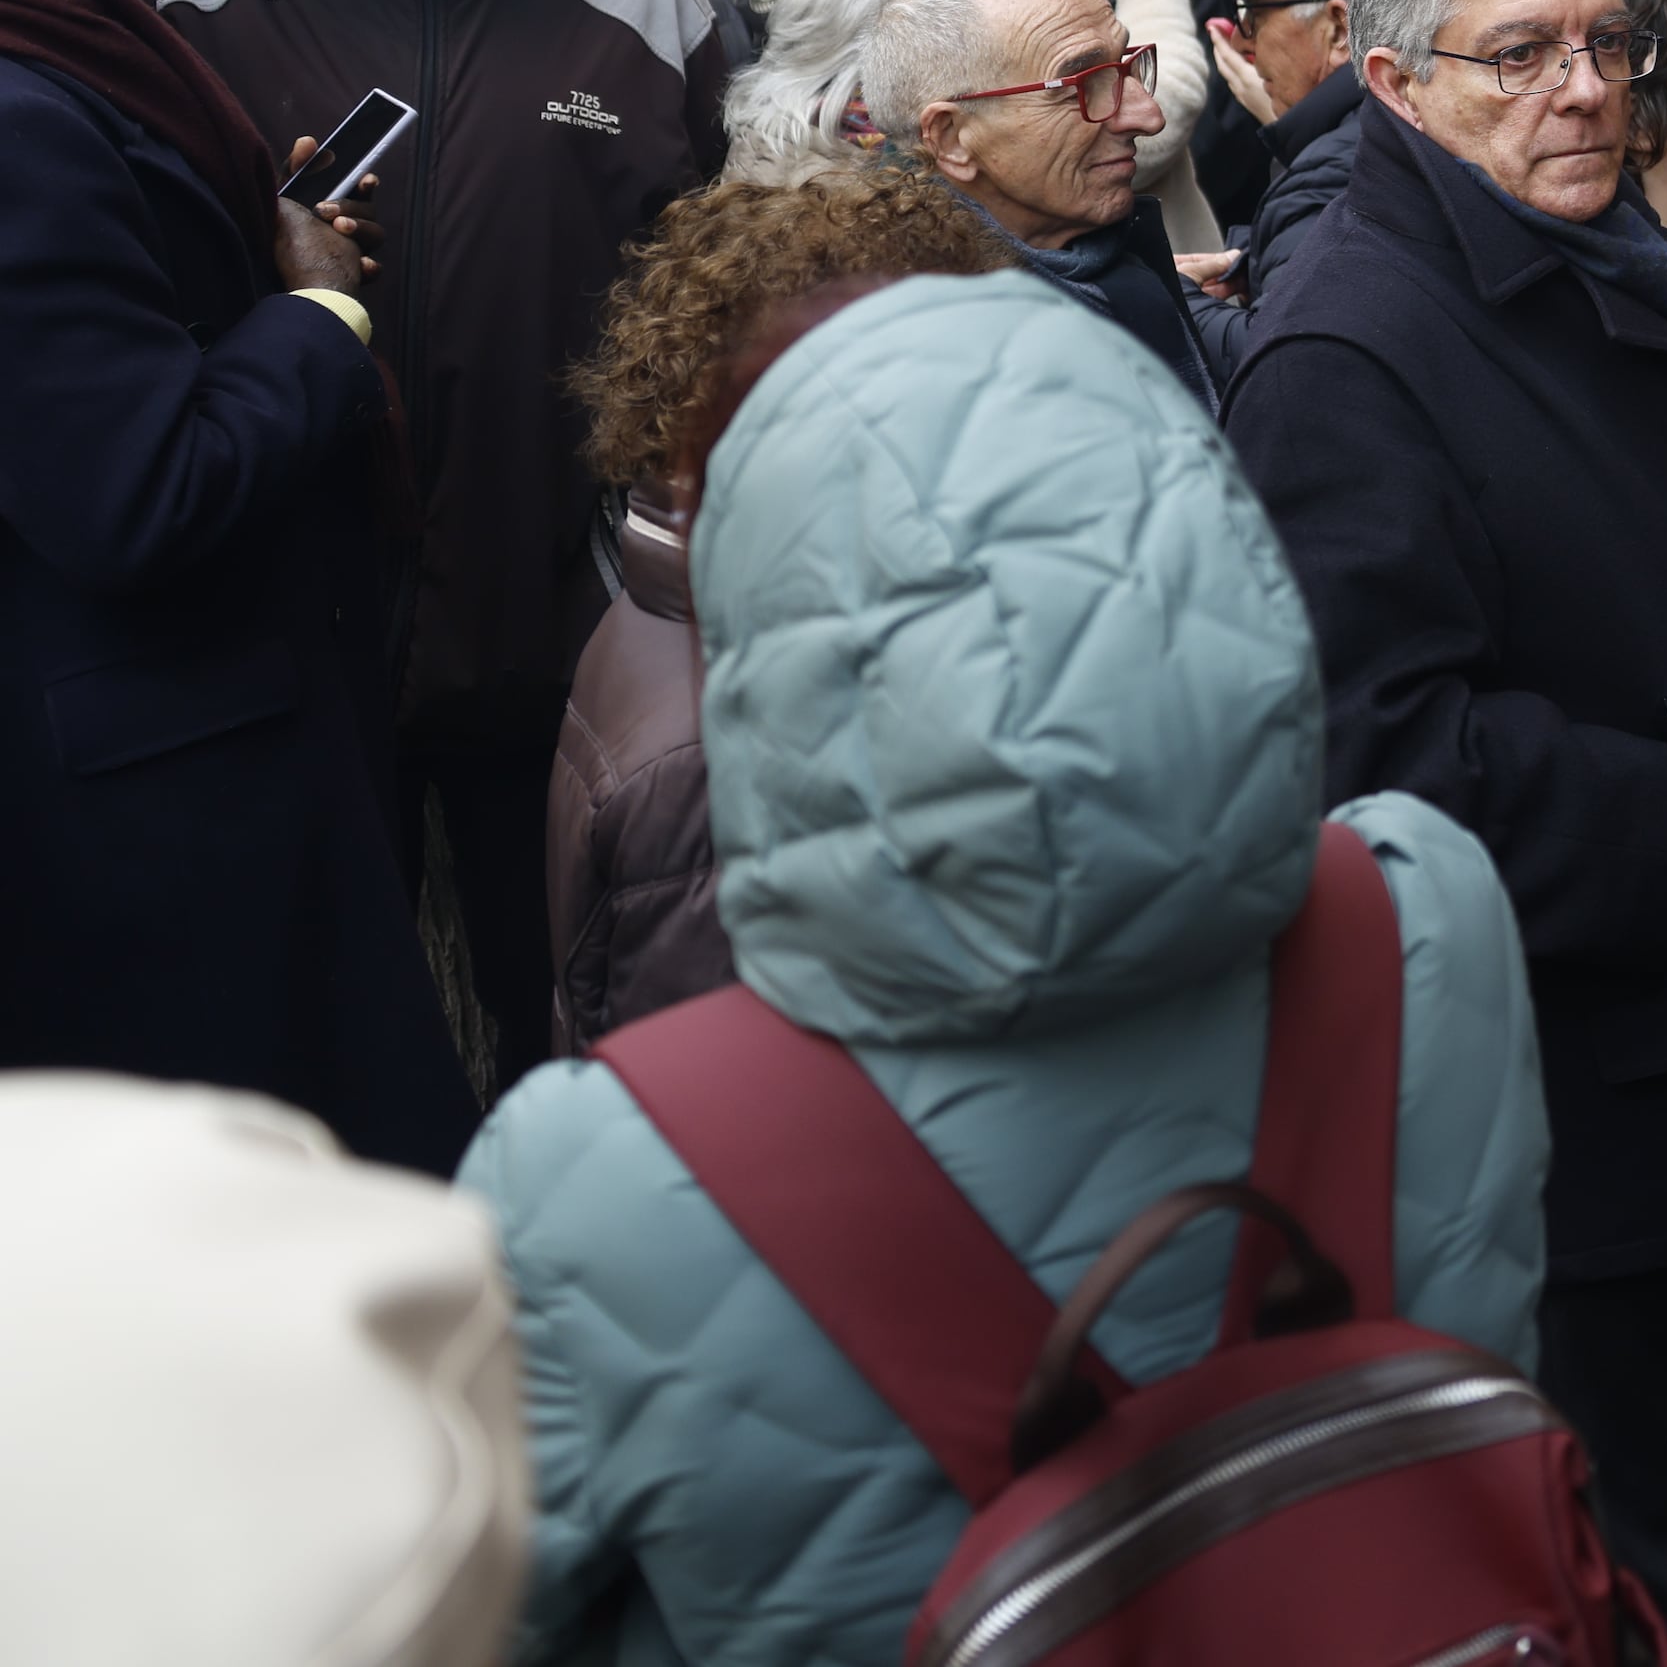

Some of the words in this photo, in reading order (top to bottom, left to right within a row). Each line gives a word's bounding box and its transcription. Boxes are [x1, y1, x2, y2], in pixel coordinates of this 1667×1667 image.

[570, 90, 601, 110] 7725
[541, 112, 572, 125] FUTURE
[547, 101, 619, 125] OUTDOOR
